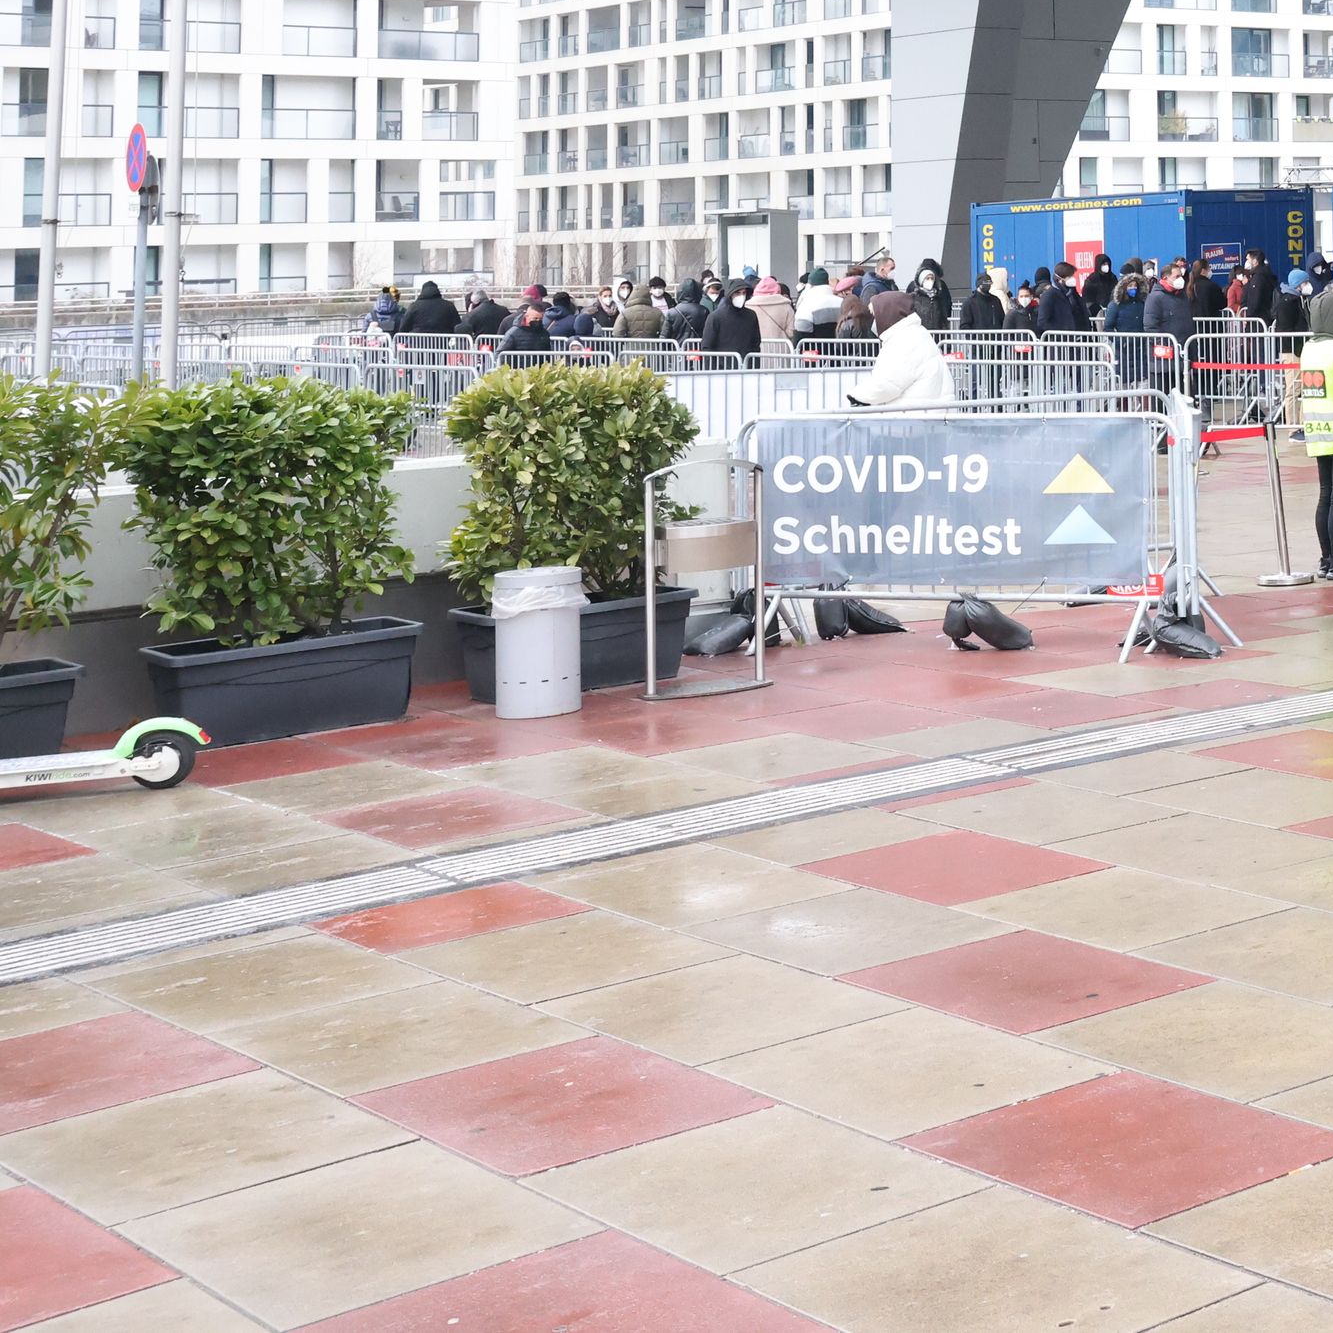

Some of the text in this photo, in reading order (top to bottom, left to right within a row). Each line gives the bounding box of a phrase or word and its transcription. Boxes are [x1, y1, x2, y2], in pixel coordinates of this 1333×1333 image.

[1010, 196, 1142, 213] www.containex.com
[773, 453, 989, 494] COVID-19
[772, 514, 1022, 556] Schnelltest
